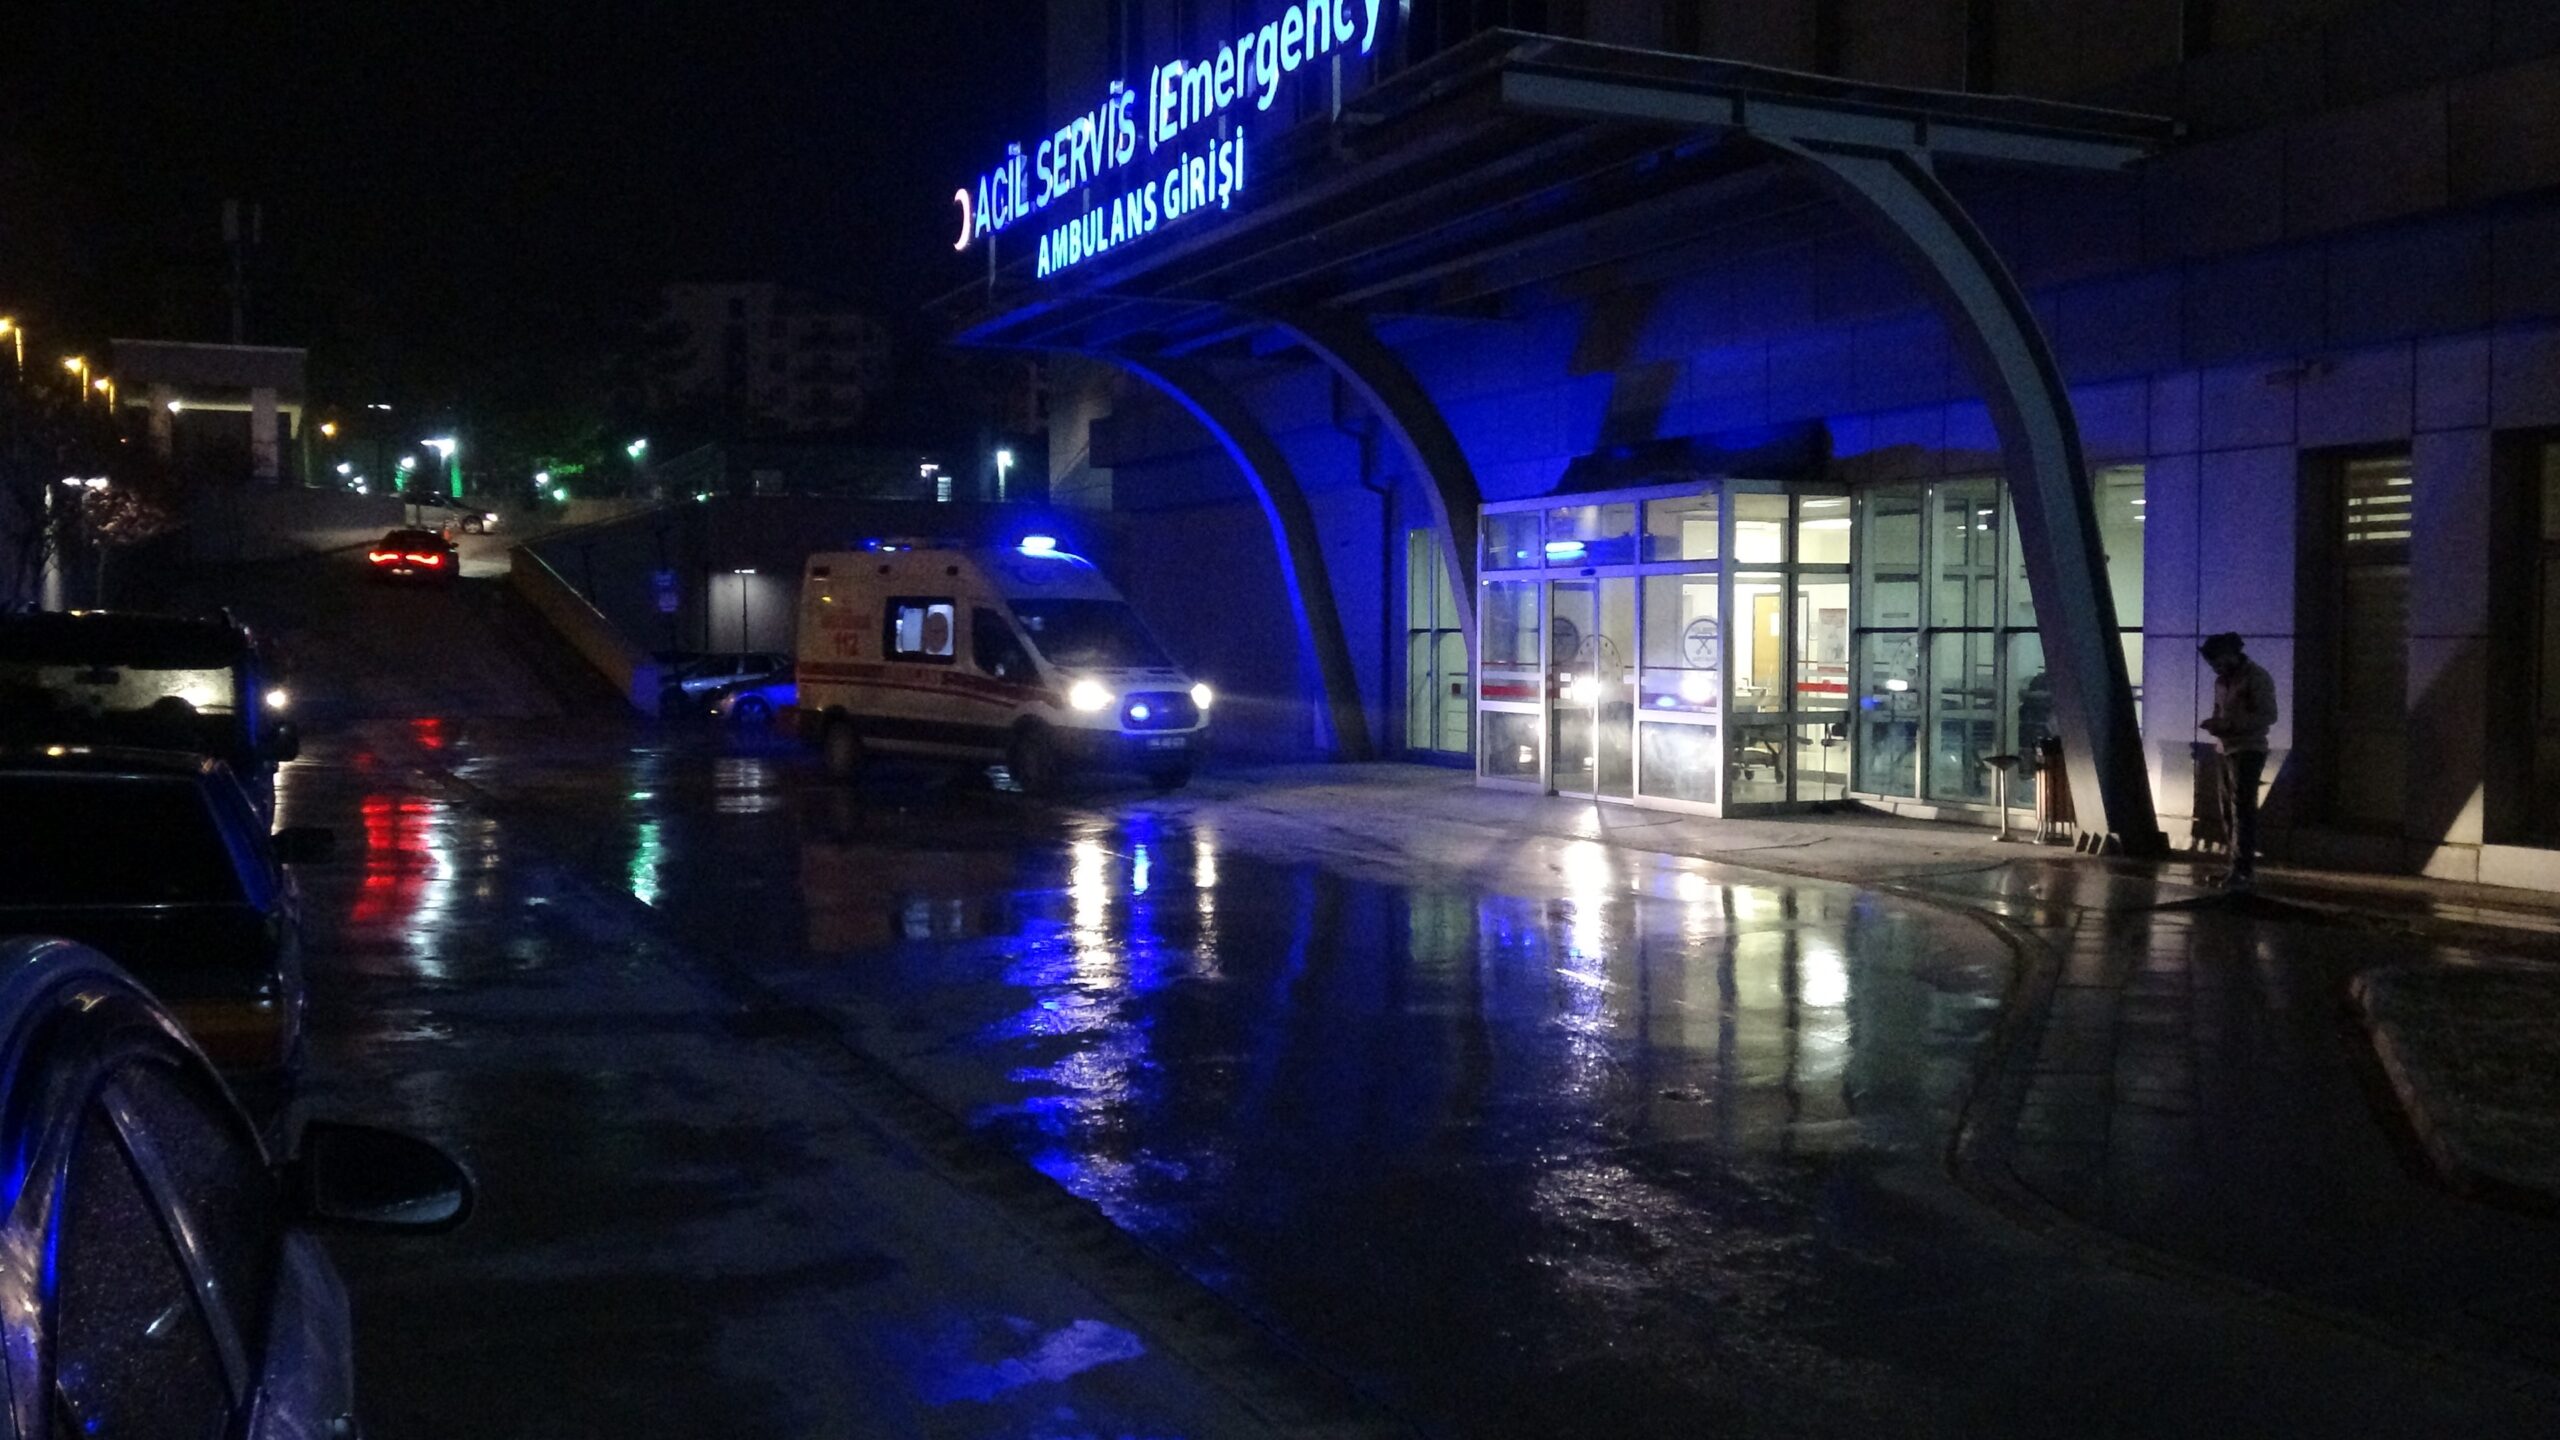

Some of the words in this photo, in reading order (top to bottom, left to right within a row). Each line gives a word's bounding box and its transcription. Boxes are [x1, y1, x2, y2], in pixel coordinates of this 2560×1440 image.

[1036, 80, 1136, 208] SERVİS
[1037, 181, 1158, 278] AMBULANS
[1163, 125, 1244, 220] GİRİŞİ
